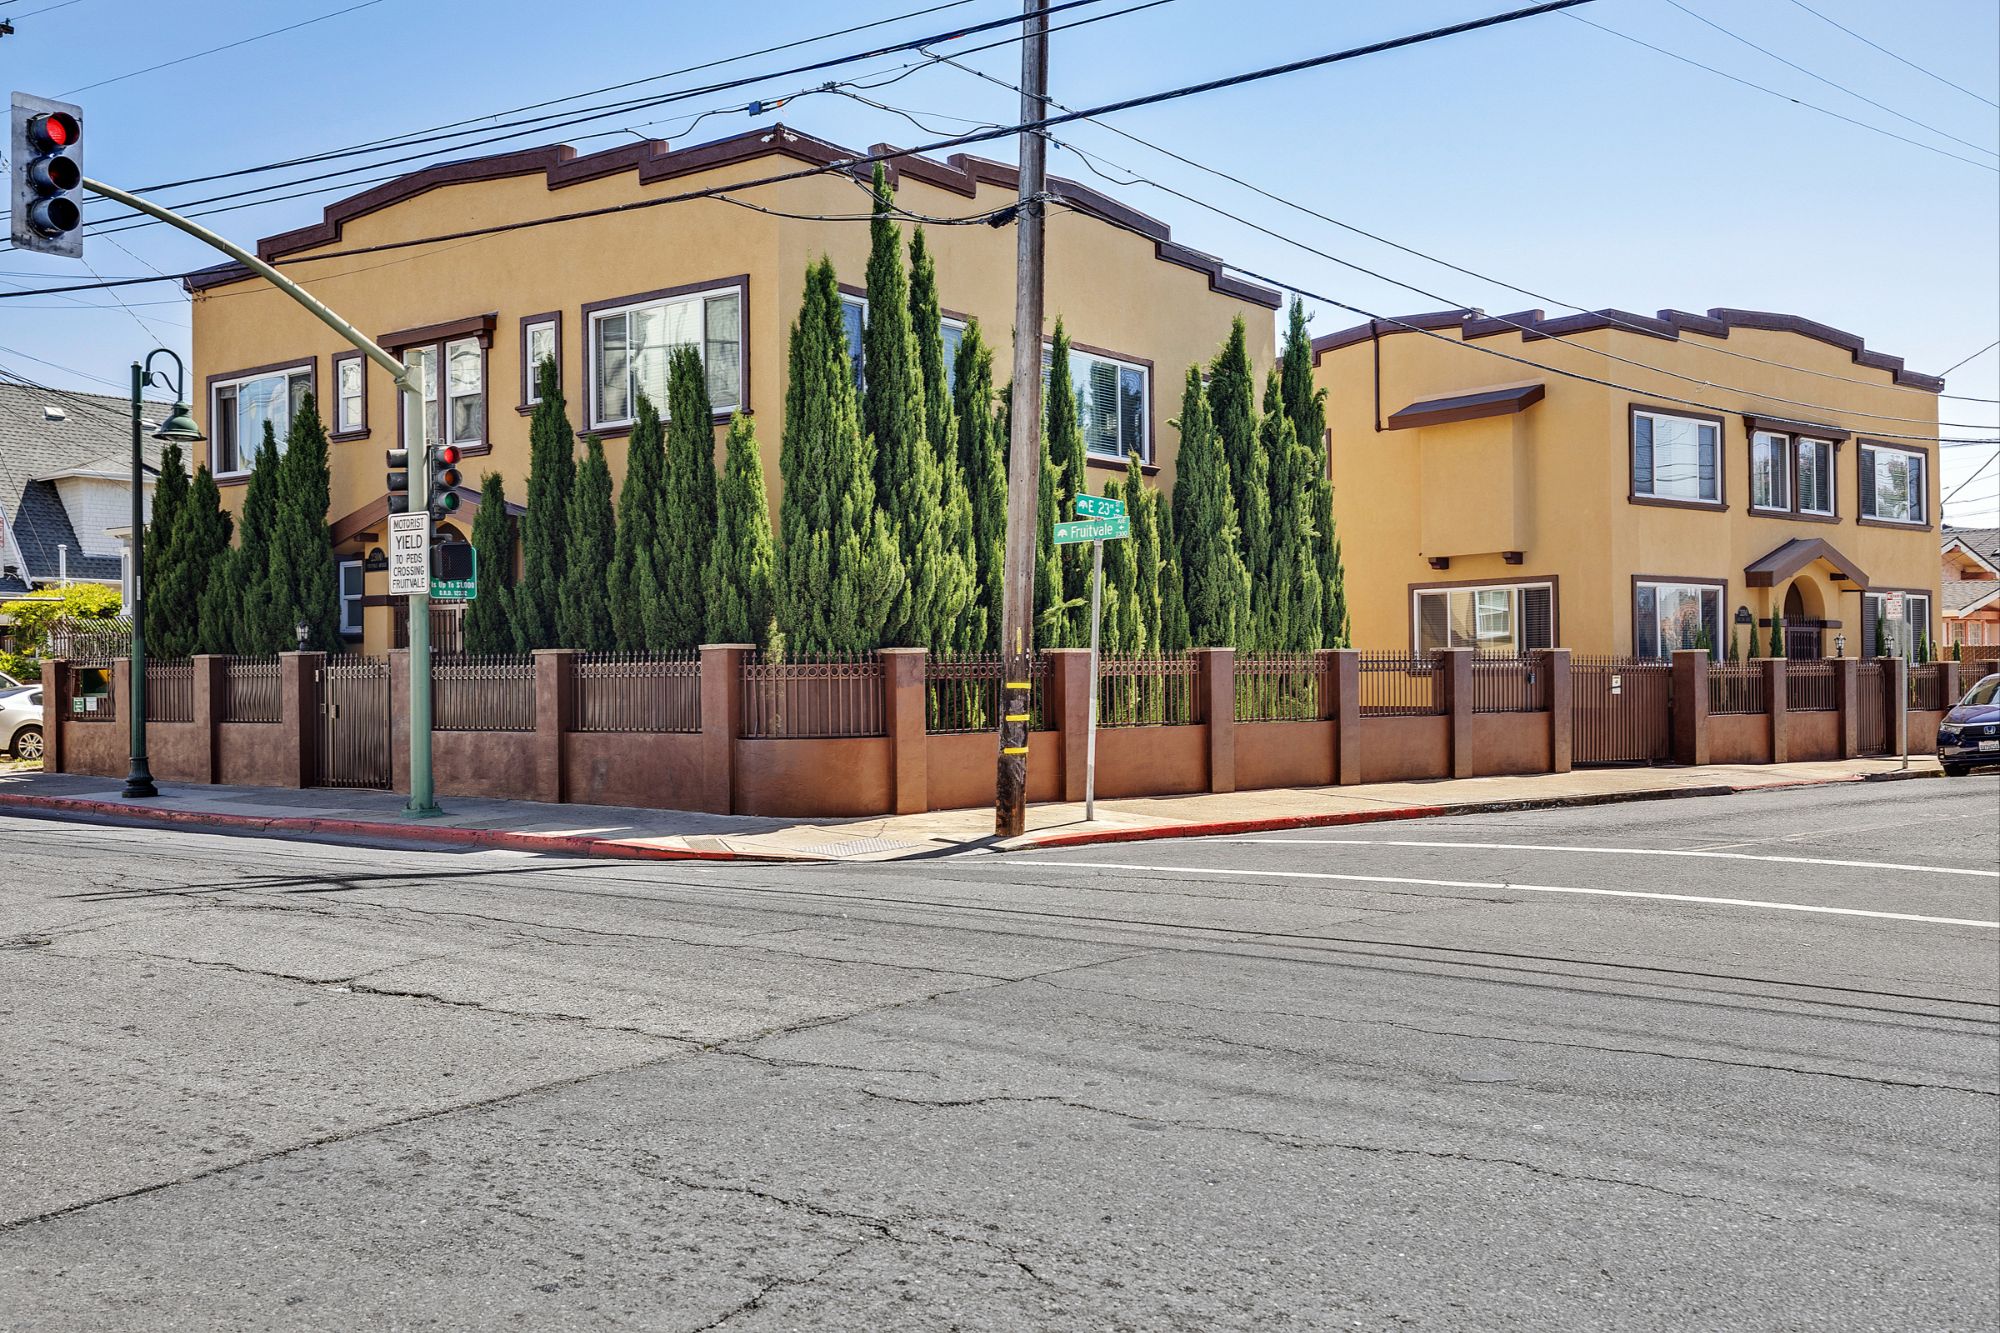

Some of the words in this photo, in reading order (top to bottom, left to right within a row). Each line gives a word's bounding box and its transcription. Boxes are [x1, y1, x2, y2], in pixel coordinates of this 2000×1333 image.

[1088, 500, 1095, 513] E
[393, 518, 424, 529] MOTORIST
[1071, 523, 1113, 538] Fruitvale
[395, 534, 423, 550] YIELD
[395, 554, 403, 564] TO
[406, 553, 423, 563] PEDS
[393, 565, 424, 577] CROSSING
[392, 578, 425, 589] FRUITVALE
[438, 581, 446, 589] Up
